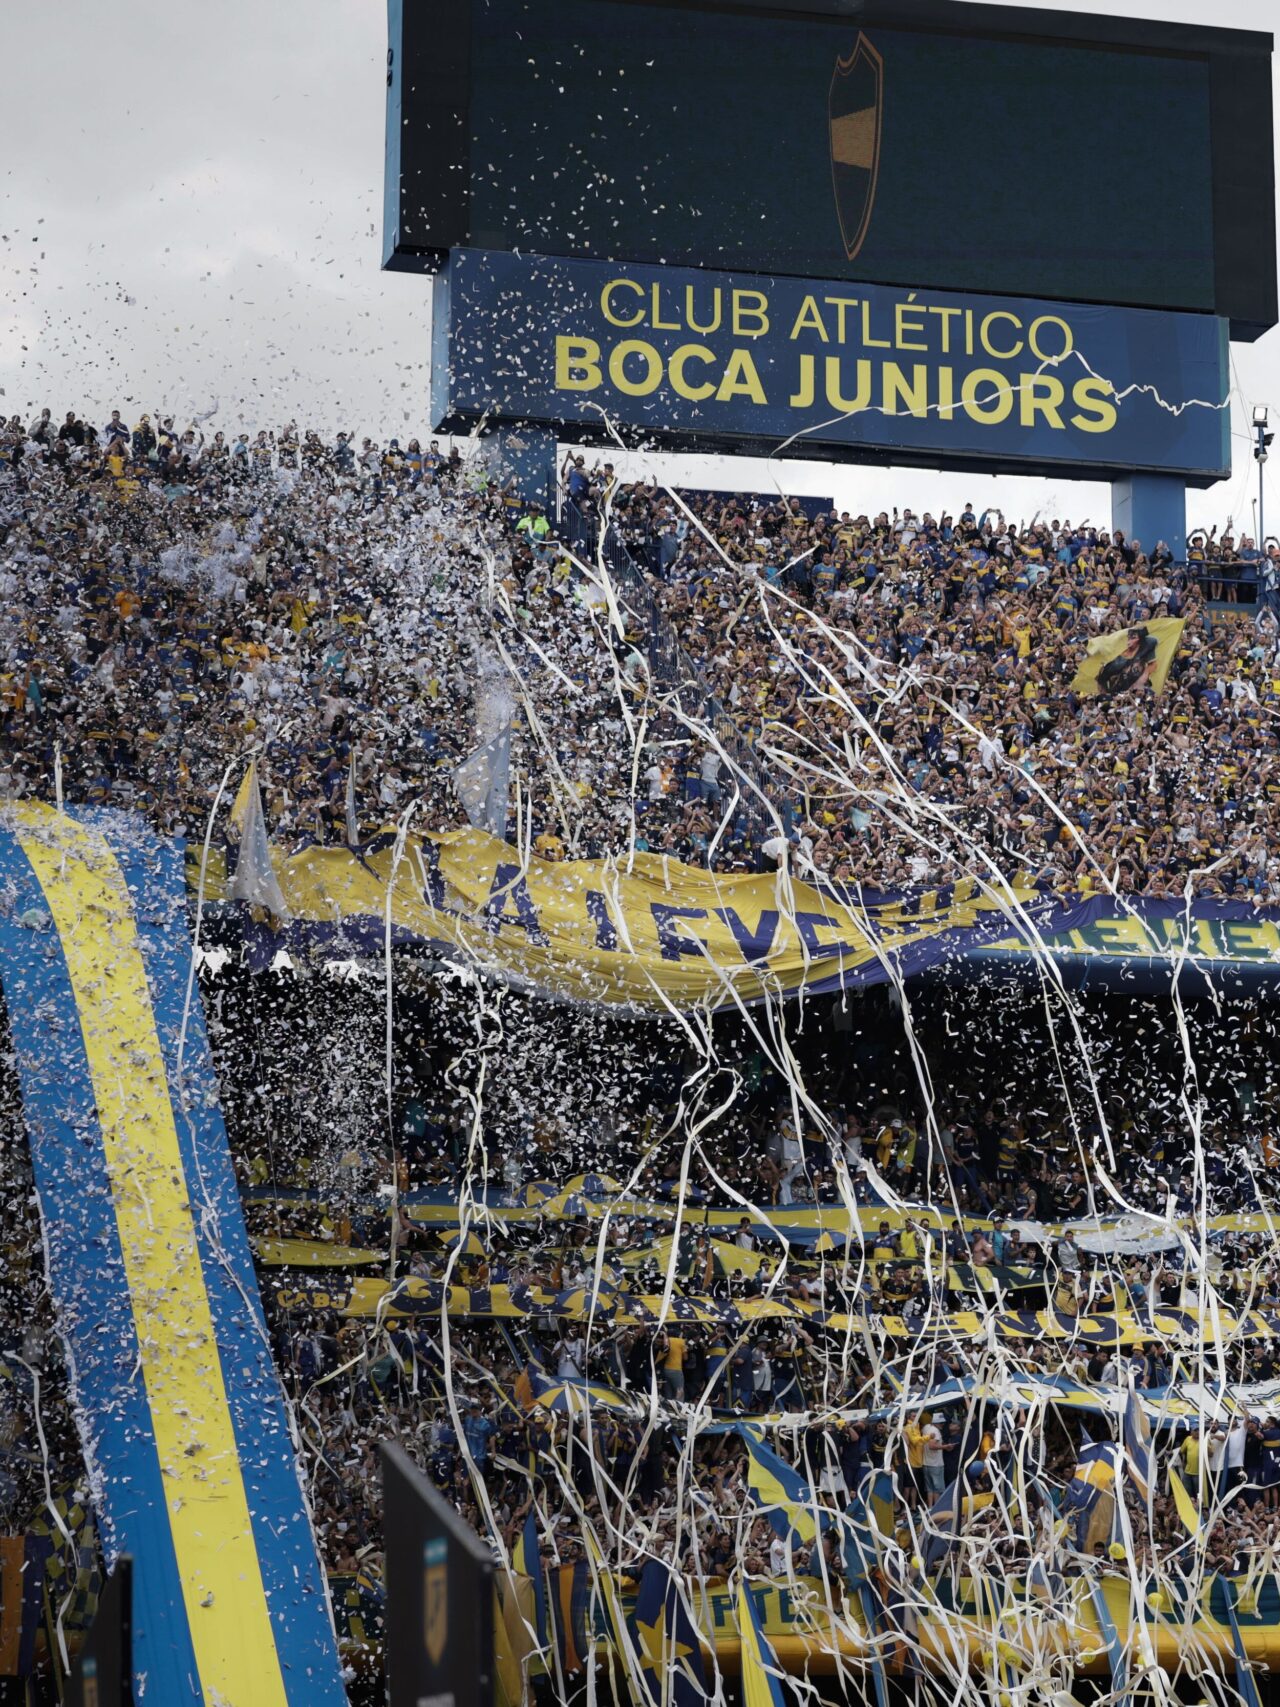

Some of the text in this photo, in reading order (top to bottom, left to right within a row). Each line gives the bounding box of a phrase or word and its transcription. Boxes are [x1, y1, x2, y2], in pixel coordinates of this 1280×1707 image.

[600, 278, 1074, 360] CLUB ATLÉTICO
[554, 335, 1117, 433] BOCA JUNIORS
[277, 1290, 347, 1309] CABJ
